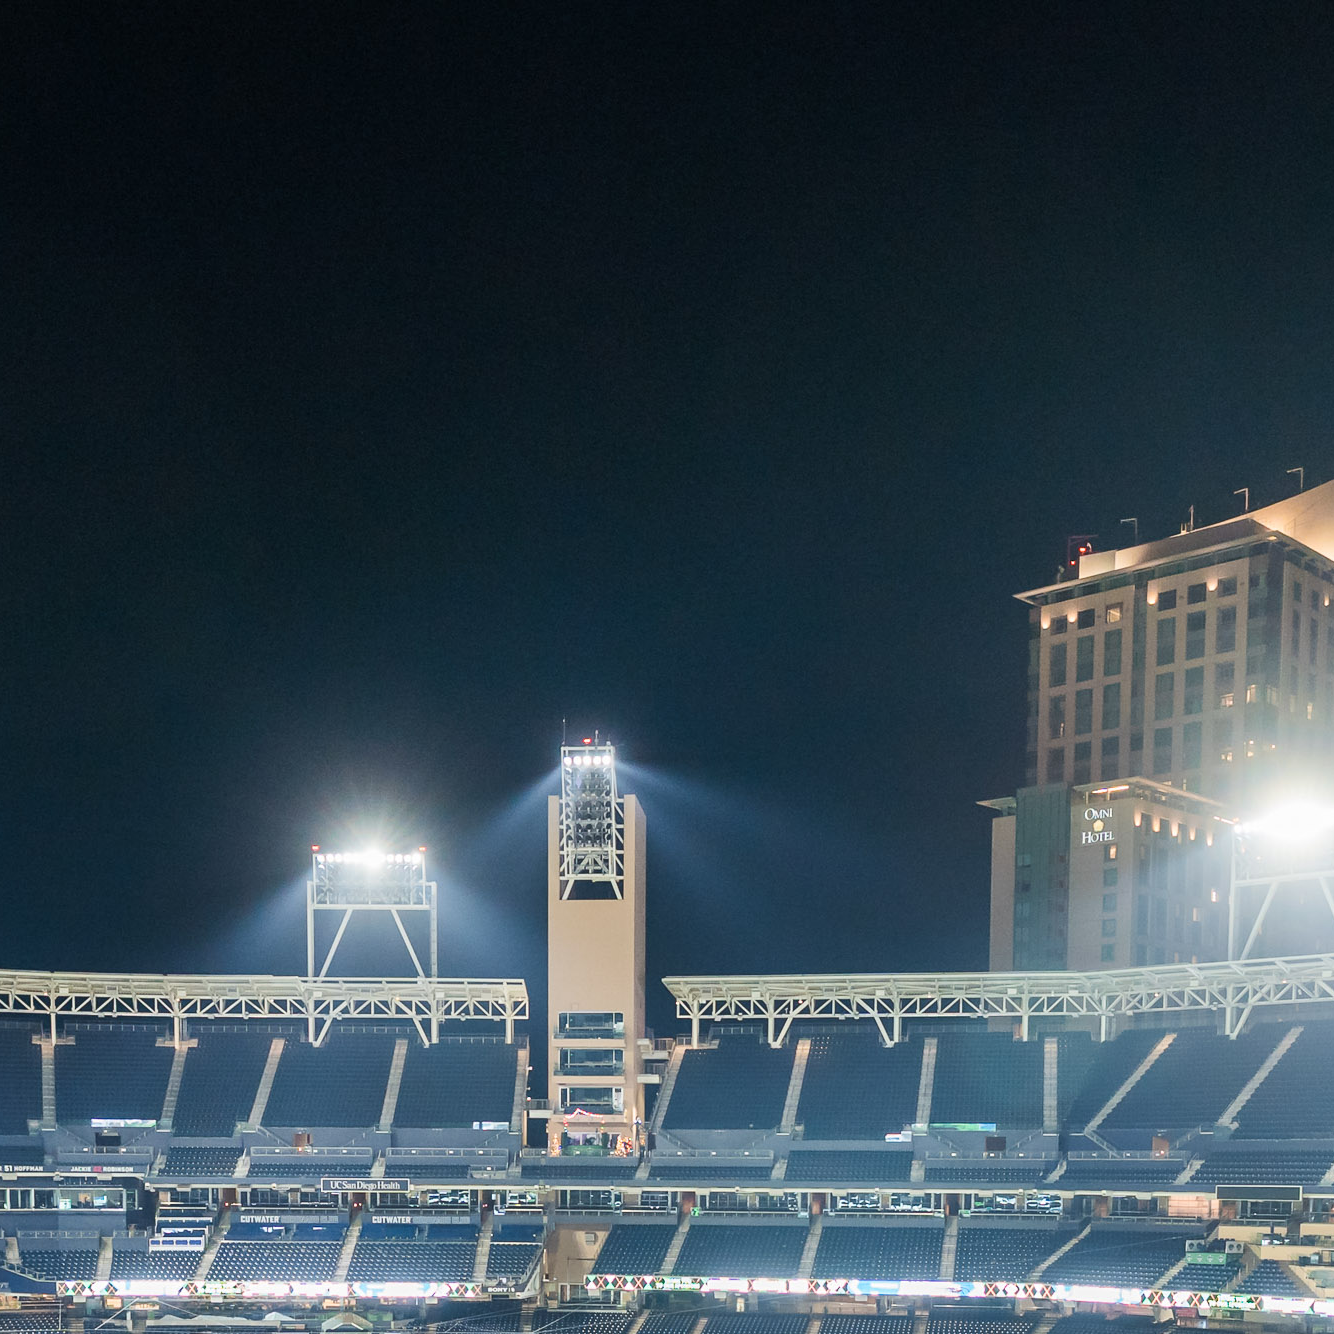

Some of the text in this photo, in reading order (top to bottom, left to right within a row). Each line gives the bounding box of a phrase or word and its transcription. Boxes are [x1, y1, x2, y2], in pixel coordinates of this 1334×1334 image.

[1084, 807, 1113, 822] OMNI
[1082, 829, 1115, 845] HOTEL
[330, 1181, 400, 1192] UC San Diego Health
[240, 1215, 280, 1224] CUTWATER
[372, 1216, 412, 1224] CUTWATER
